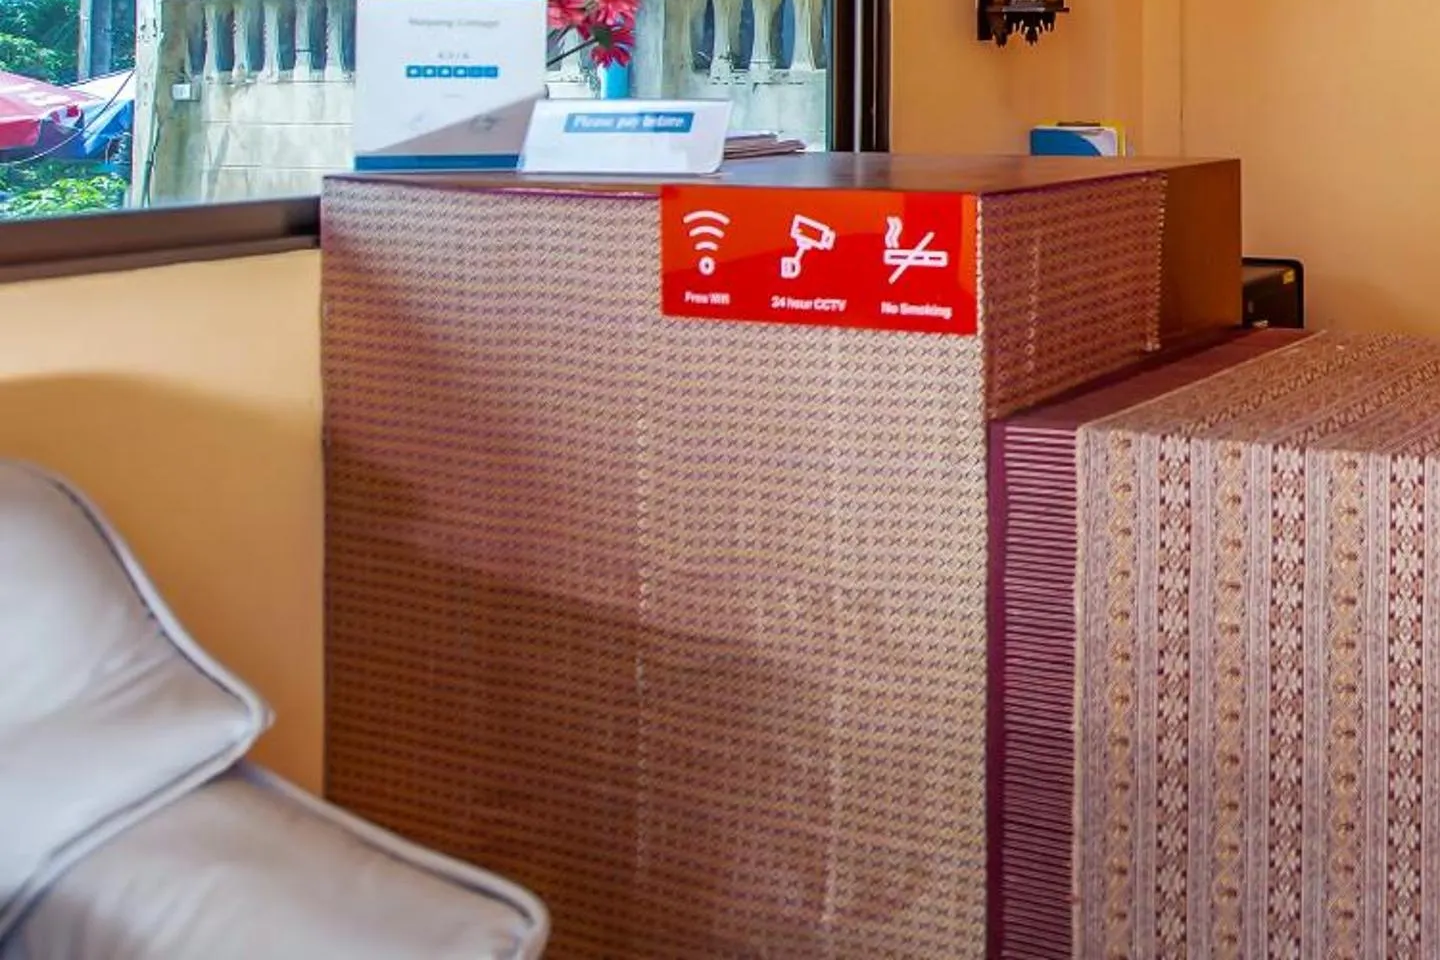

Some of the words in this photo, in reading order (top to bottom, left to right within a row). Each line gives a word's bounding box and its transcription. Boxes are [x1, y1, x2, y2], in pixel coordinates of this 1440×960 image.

[771, 295, 786, 309] 24
[787, 296, 815, 310] hour
[814, 297, 847, 312] CCTV
[881, 302, 899, 315] No
[899, 303, 952, 319] Smoking
